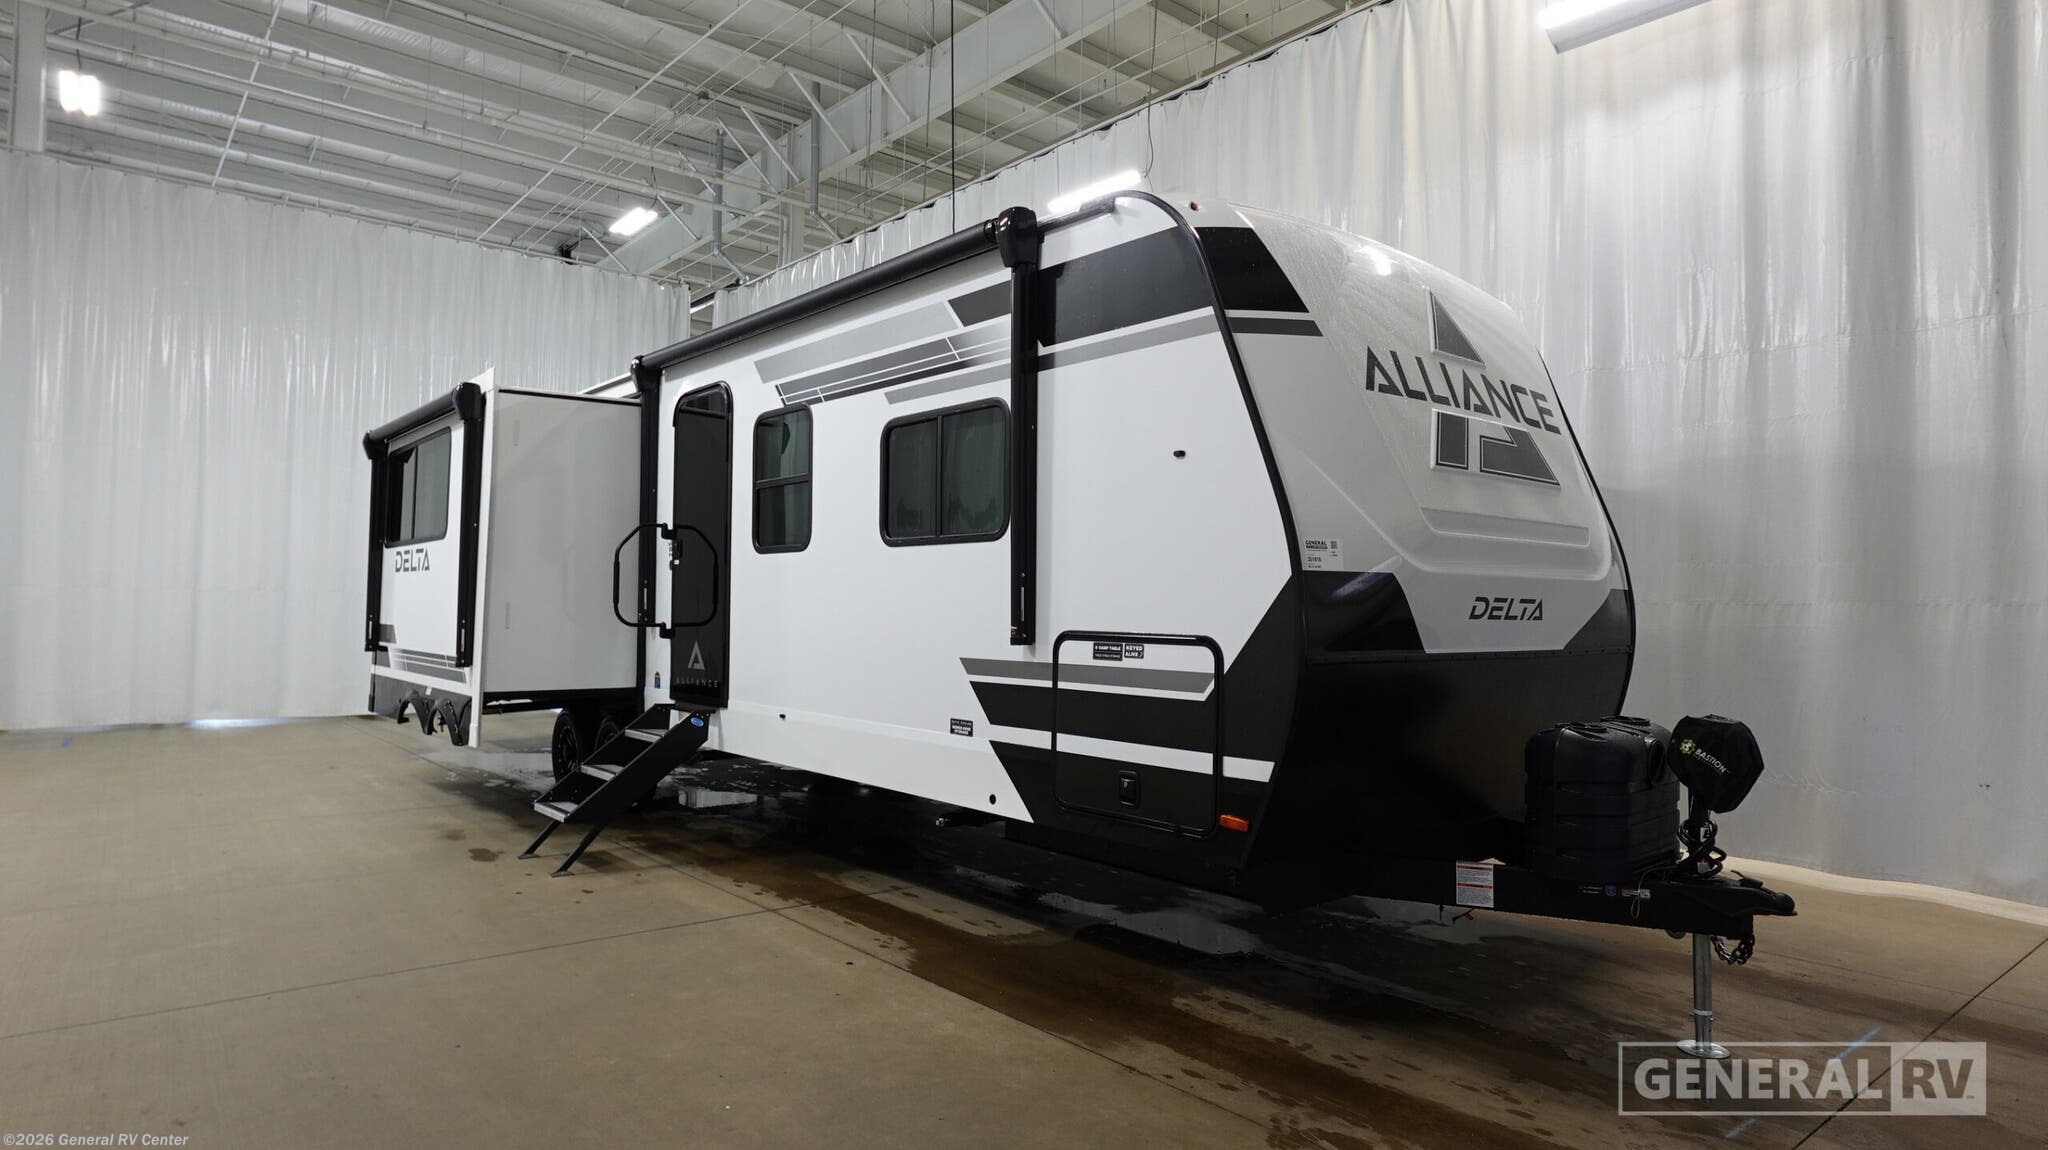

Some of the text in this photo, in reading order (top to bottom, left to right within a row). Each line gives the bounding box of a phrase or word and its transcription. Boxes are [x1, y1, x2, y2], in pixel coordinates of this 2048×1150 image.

[1365, 345, 1562, 435] ALLIANCE
[395, 548, 430, 573] DELTA
[1469, 596, 1543, 621] DELTA
[1695, 748, 1727, 773] BASTION
